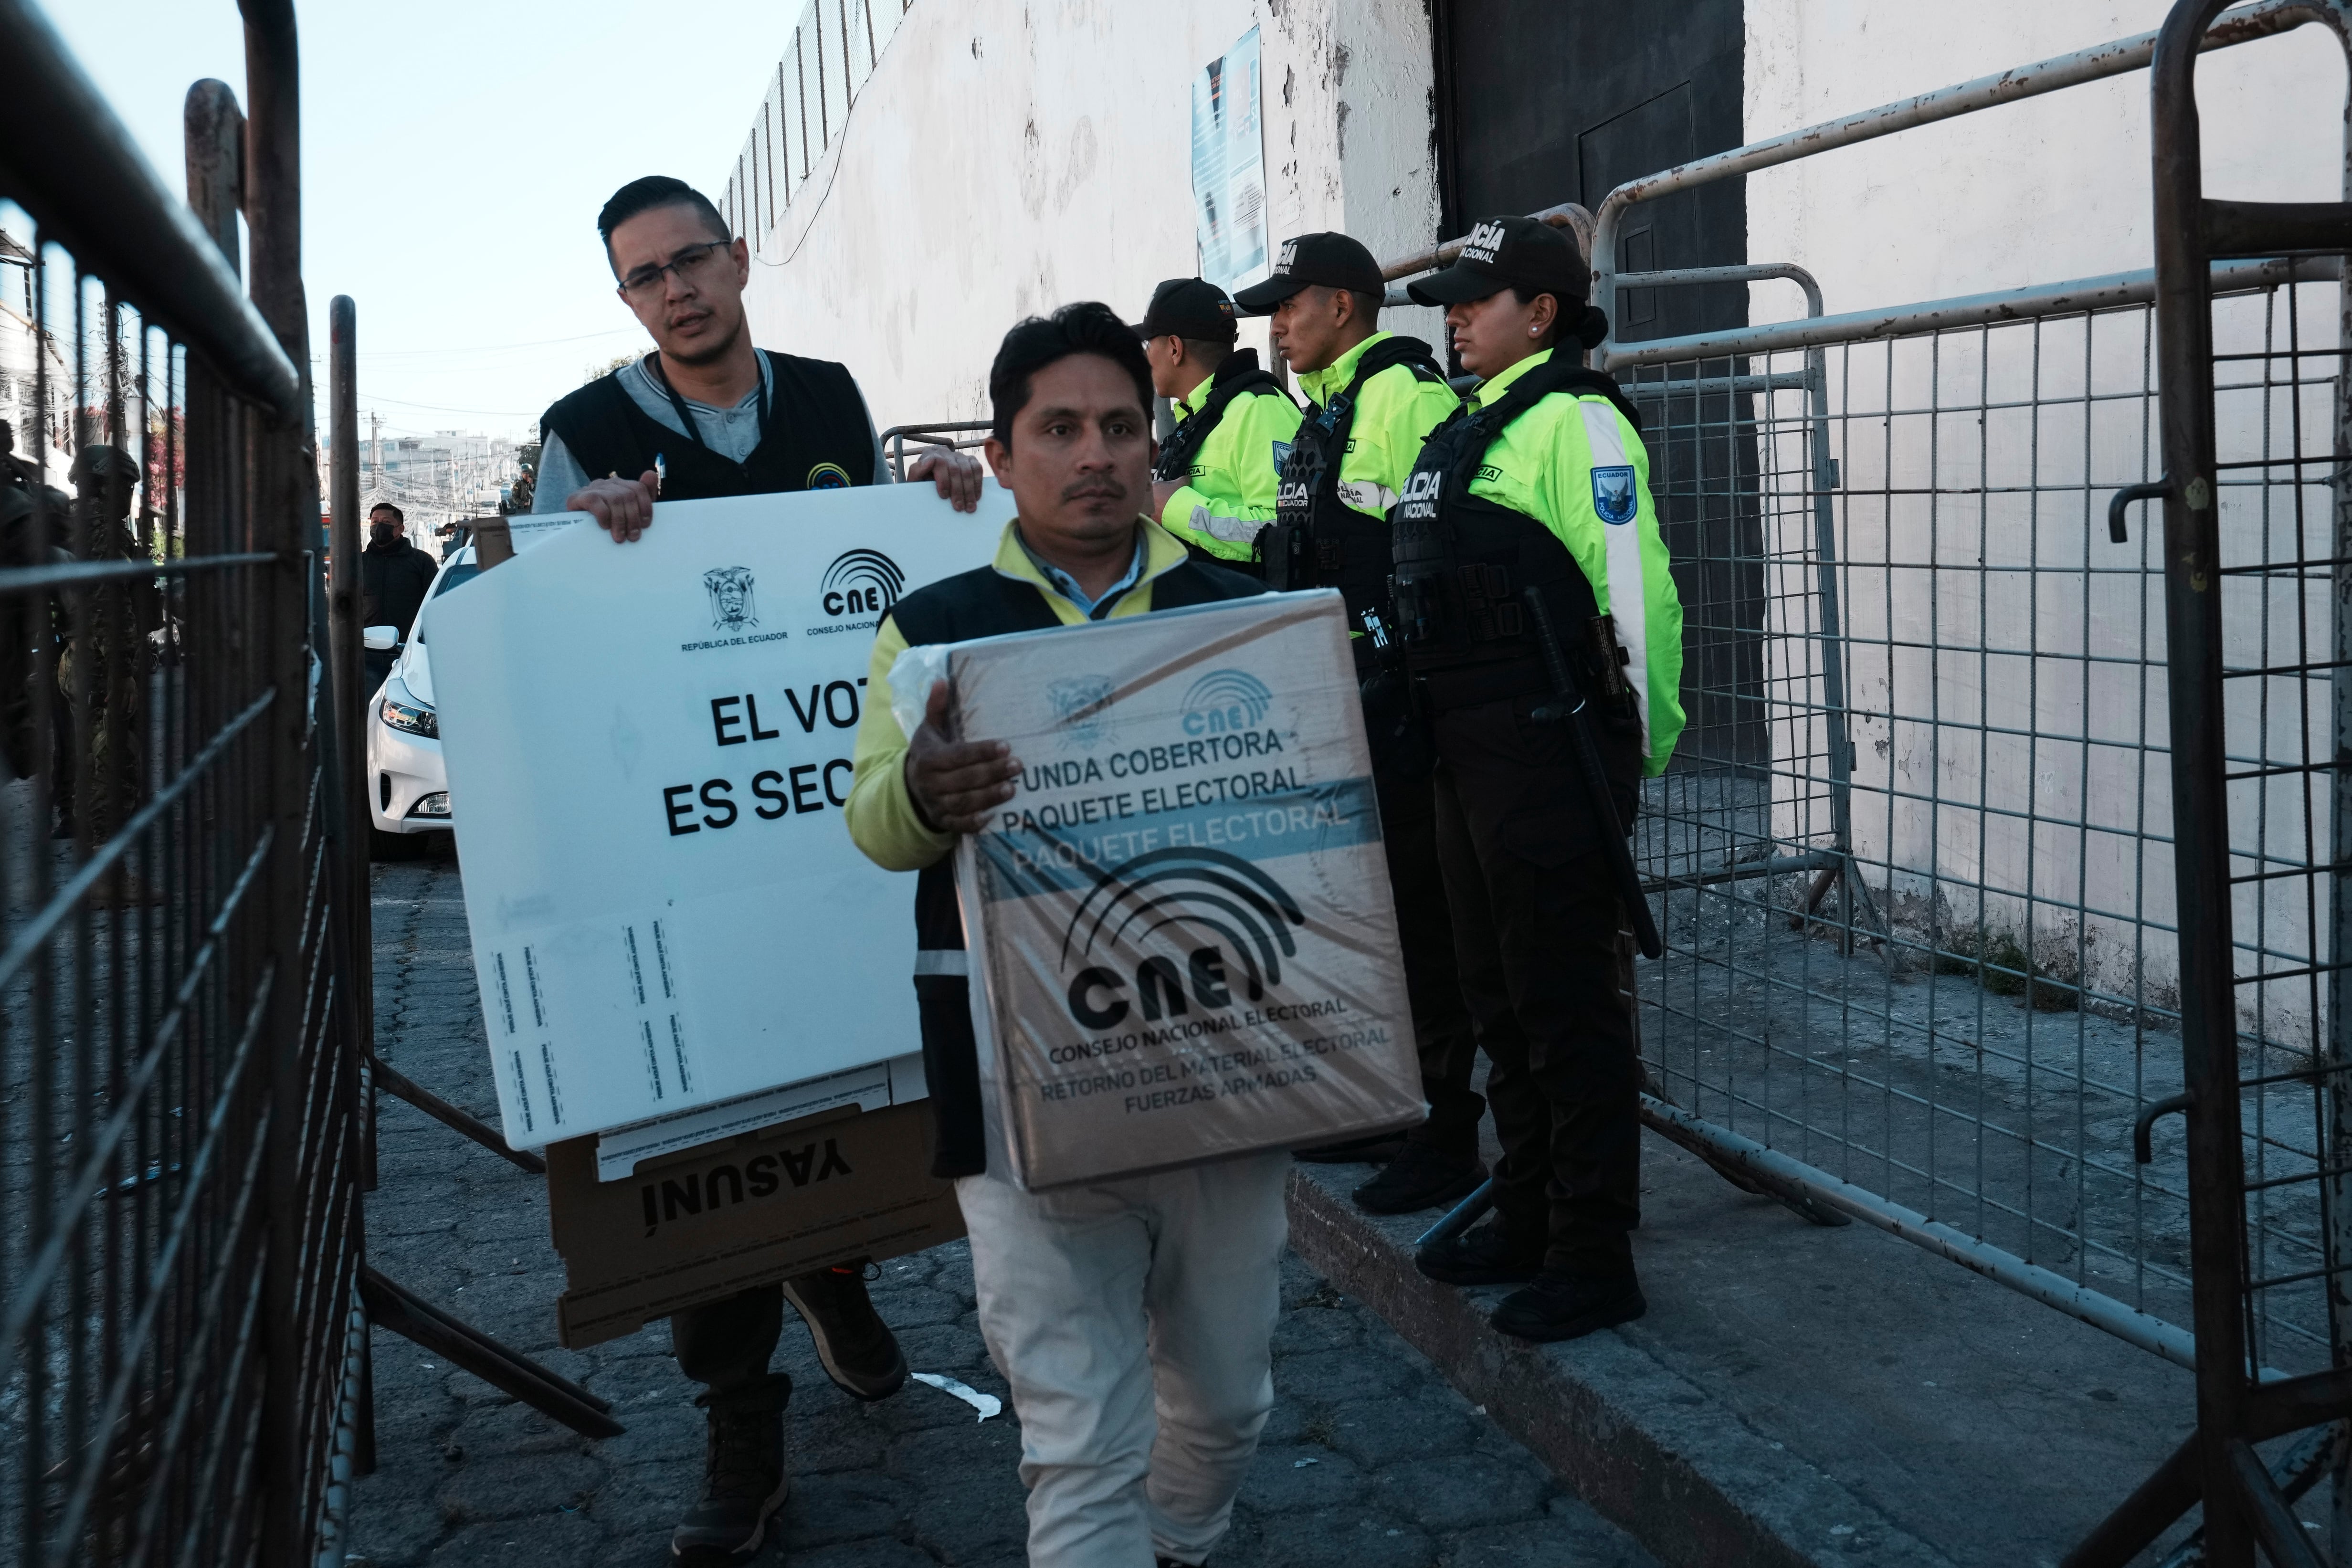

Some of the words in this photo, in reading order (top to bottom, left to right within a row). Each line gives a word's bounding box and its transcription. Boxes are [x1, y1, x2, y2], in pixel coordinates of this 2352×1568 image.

[1459, 247, 1494, 263] ACIONAL
[1465, 220, 1505, 251] ICÍA
[1274, 266, 1290, 275] IONAL
[1403, 502, 1436, 518] NACIONAL
[1599, 502, 1614, 519] POLICIA
[1617, 501, 1634, 520] NACIONAL
[823, 587, 879, 616] CNE
[681, 637, 729, 652] REPÚBLICA
[730, 636, 748, 646] DEL
[748, 631, 788, 644] ECUADOR
[807, 624, 844, 636] CONSEJO
[845, 620, 879, 631] NACIONA
[711, 694, 780, 747] EL
[1182, 705, 1243, 736] CNE
[1110, 728, 1284, 779] COBERTORA
[663, 778, 738, 836] ES
[1003, 793, 1134, 837] PAQUETE
[1141, 767, 1307, 814] ELECTORAL
[1013, 828, 1159, 874] PAQUETE
[1169, 802, 1350, 848] ELECTORAL
[1068, 946, 1233, 1031] CNE
[1050, 1034, 1138, 1064] CONSEJO
[1142, 1015, 1241, 1046] NACIONAL
[1245, 999, 1348, 1026] ELECTORAL
[1041, 1071, 1135, 1102] RETORNO
[1140, 1064, 1177, 1086] DEL
[1180, 1047, 1277, 1077] MATERIAL
[1280, 1028, 1391, 1060] ELECTORAL
[1125, 1083, 1216, 1114] FUERZAS
[1221, 1065, 1317, 1096] ARMADAS
[642, 1138, 853, 1239] YASUNÍ
